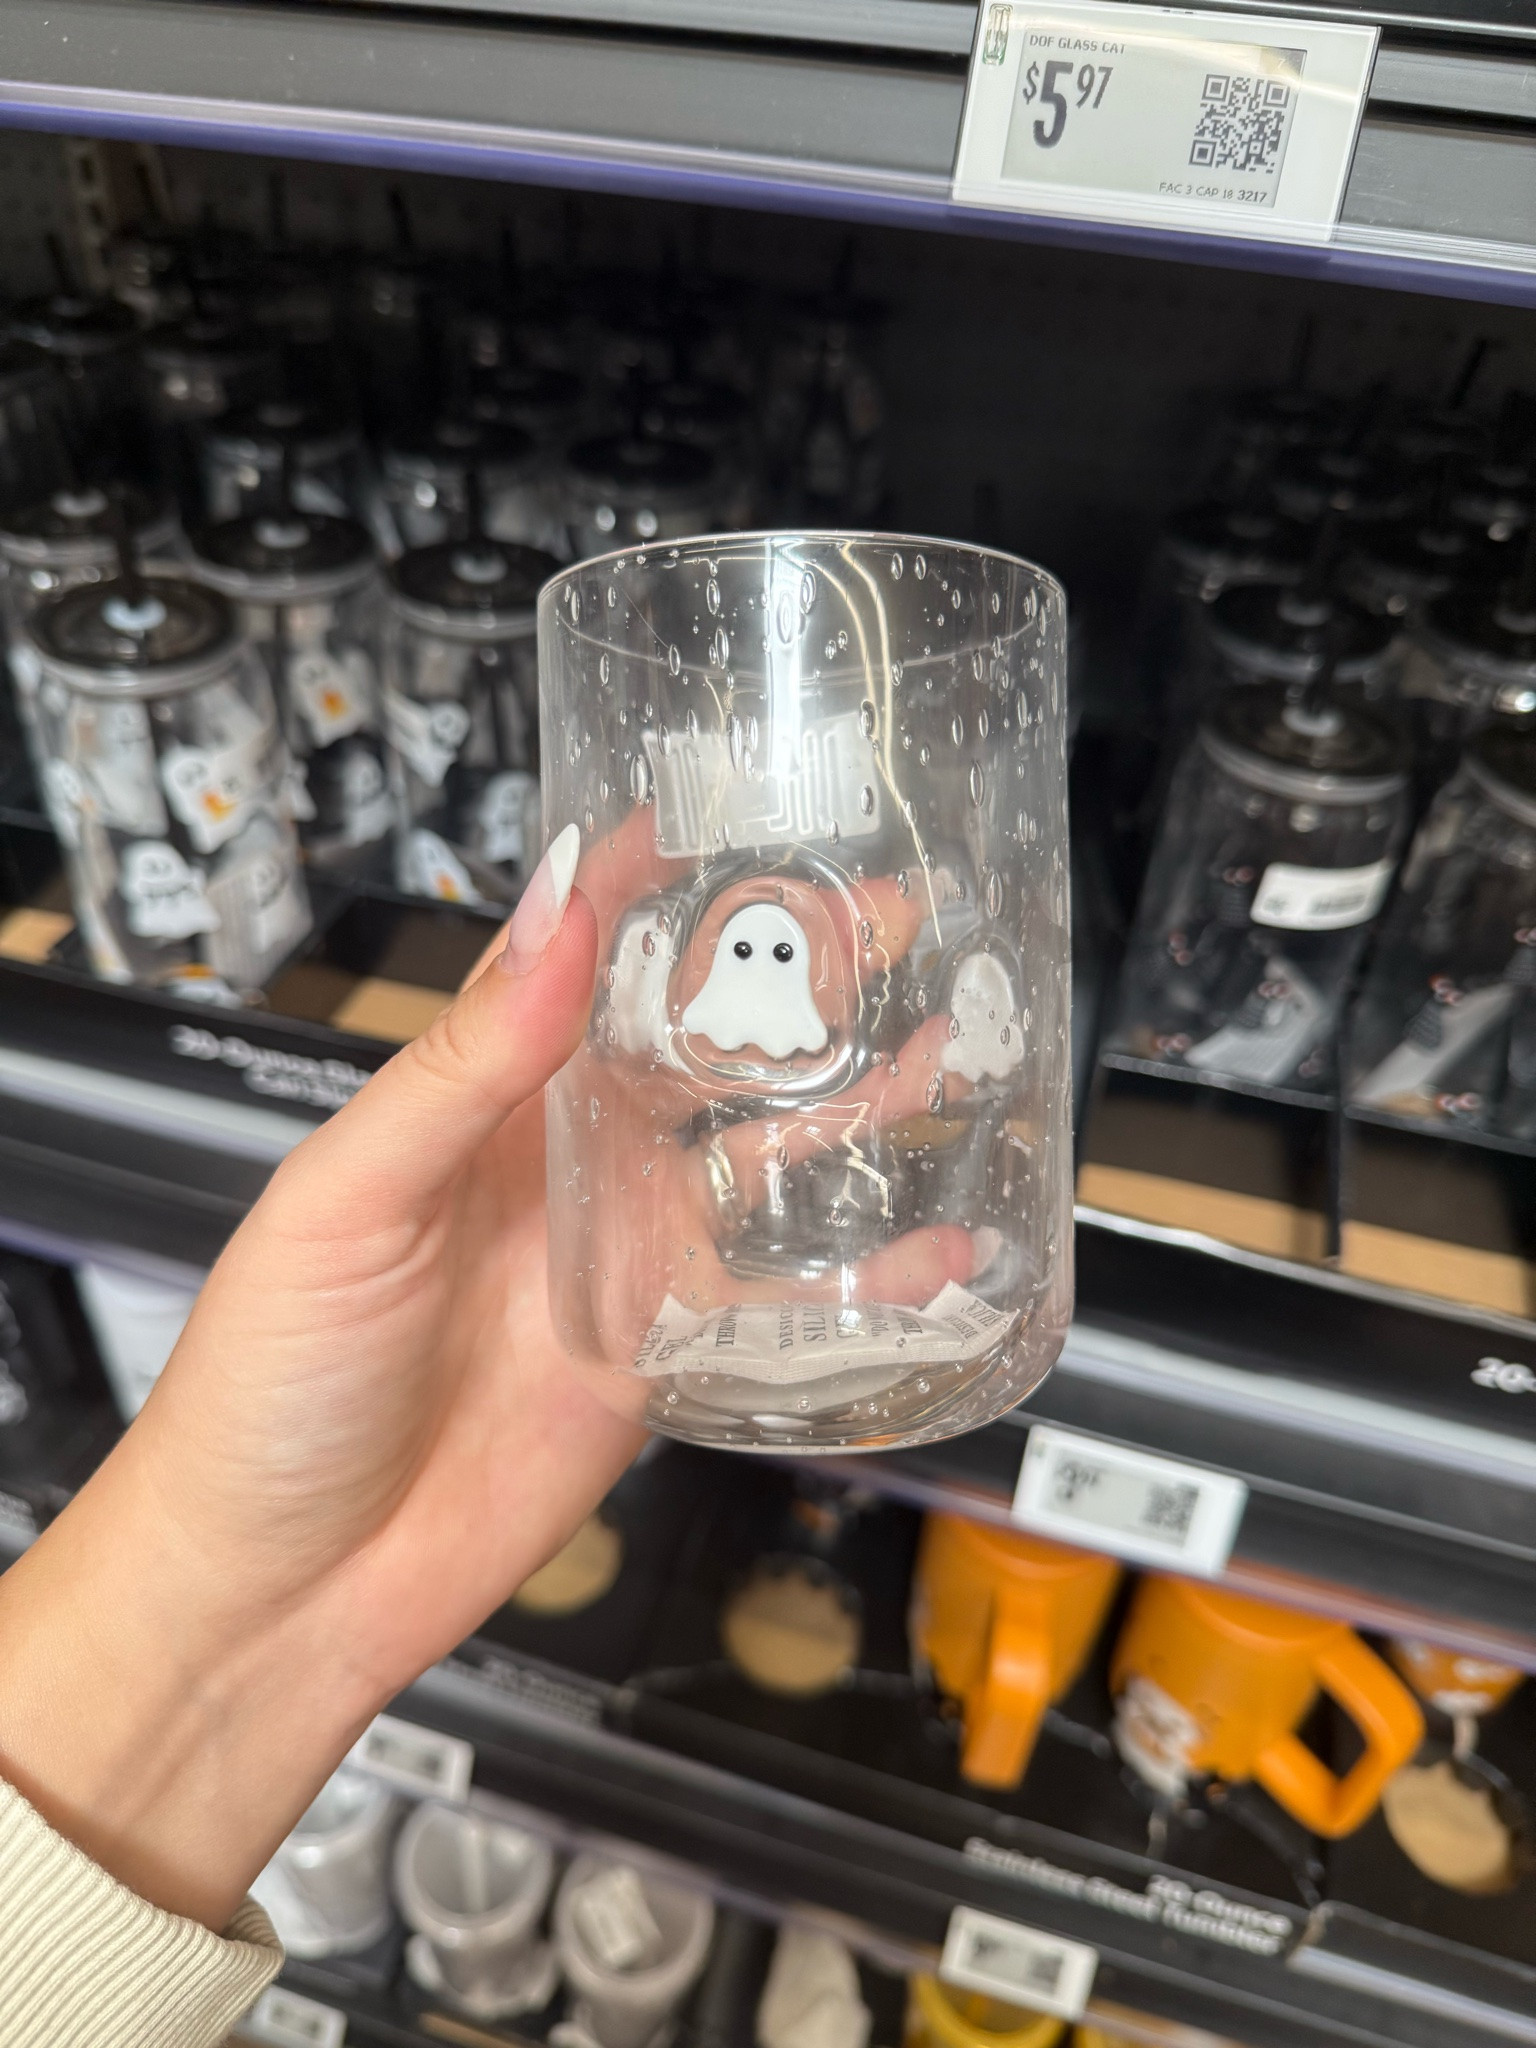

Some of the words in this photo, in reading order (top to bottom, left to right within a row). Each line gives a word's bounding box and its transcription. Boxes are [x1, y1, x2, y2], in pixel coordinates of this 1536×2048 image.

[1029, 34, 1055, 48] DOF
[1058, 36, 1098, 52] GLASS
[1101, 41, 1126, 55] CAT
[1158, 181, 1183, 195] FAC
[1185, 183, 1193, 196] 3
[1196, 186, 1219, 199] CAP
[1222, 188, 1234, 200] 18
[1237, 189, 1268, 204] 3217
